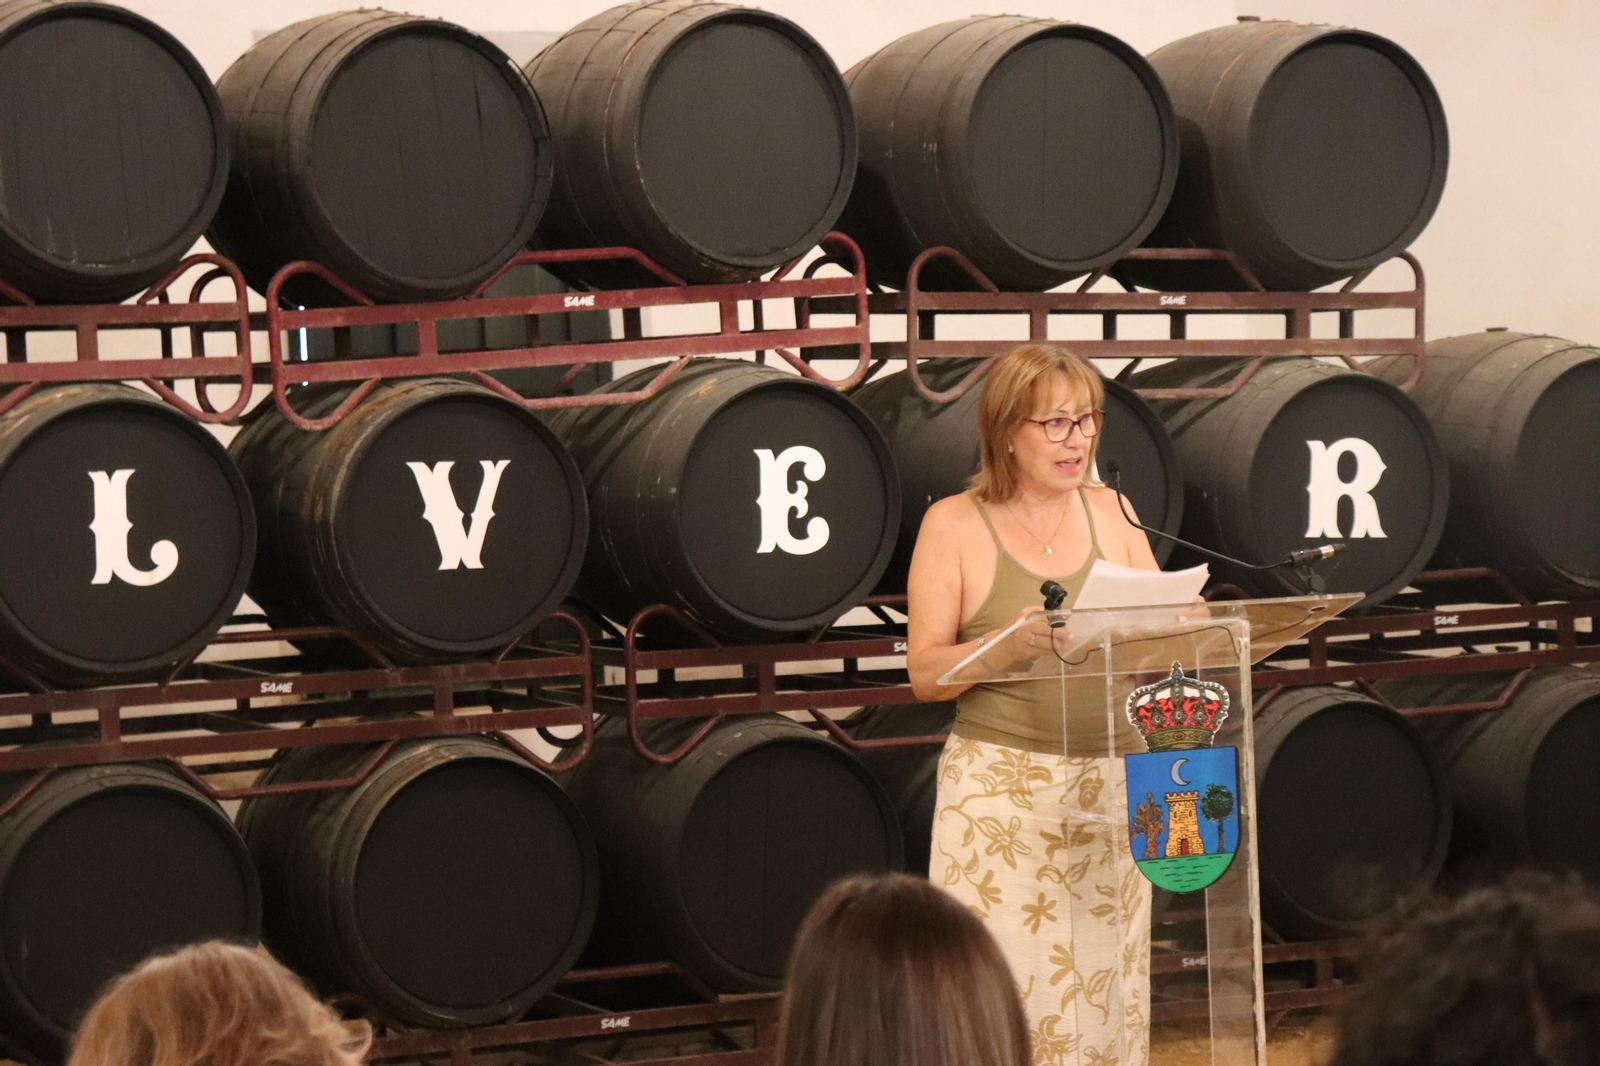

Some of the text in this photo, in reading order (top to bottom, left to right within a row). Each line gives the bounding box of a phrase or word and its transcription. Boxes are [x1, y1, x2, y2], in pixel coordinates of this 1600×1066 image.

[564, 295, 595, 308] SAME
[1160, 295, 1187, 306] SAME
[87, 437, 1388, 587] L V E R
[1434, 615, 1459, 626] SAME
[894, 642, 907, 652] SA
[261, 682, 294, 693] SAME
[1182, 956, 1207, 967] SAME
[601, 1016, 631, 1030] SAME
